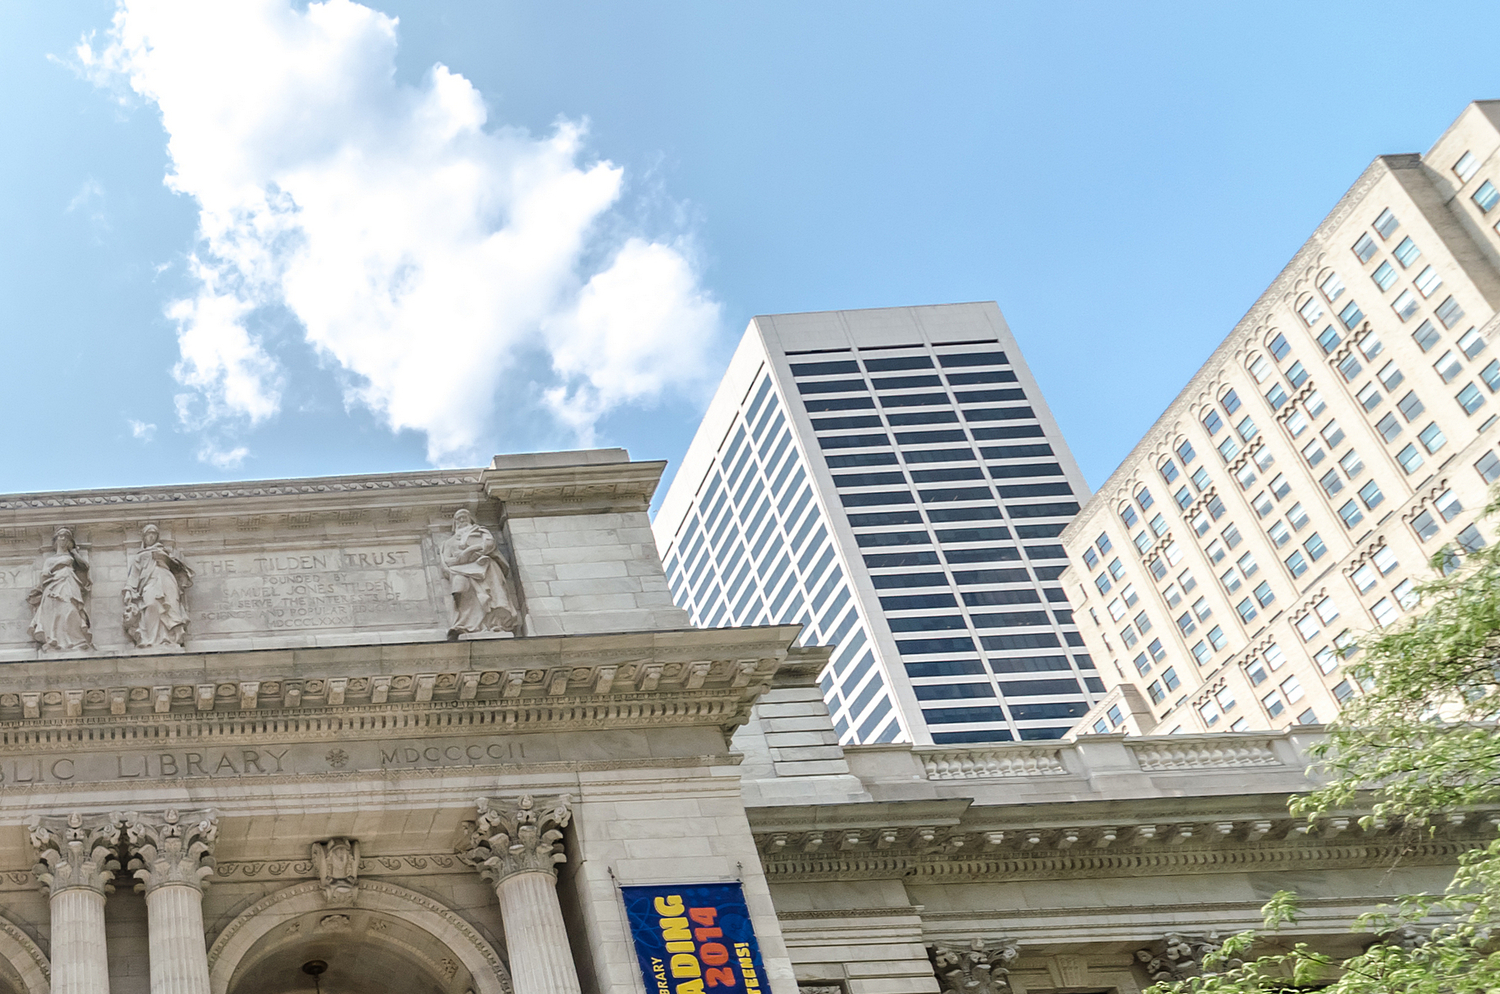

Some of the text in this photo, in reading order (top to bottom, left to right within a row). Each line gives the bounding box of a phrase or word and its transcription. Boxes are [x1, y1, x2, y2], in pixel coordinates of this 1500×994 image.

[195, 550, 409, 576] THE TILDEN TRUST
[261, 573, 348, 585] FOUNDED BY
[222, 580, 393, 598] SAMUEL JONES TILDEN
[238, 599, 273, 608] SERVE
[280, 597, 306, 606] THE
[386, 592, 401, 601] OF
[260, 608, 284, 618] AND
[290, 605, 347, 617] POPULAR
[116, 749, 290, 779] LIBRARY
[380, 743, 526, 764] MDCCCCII
[689, 907, 736, 988] 2014
